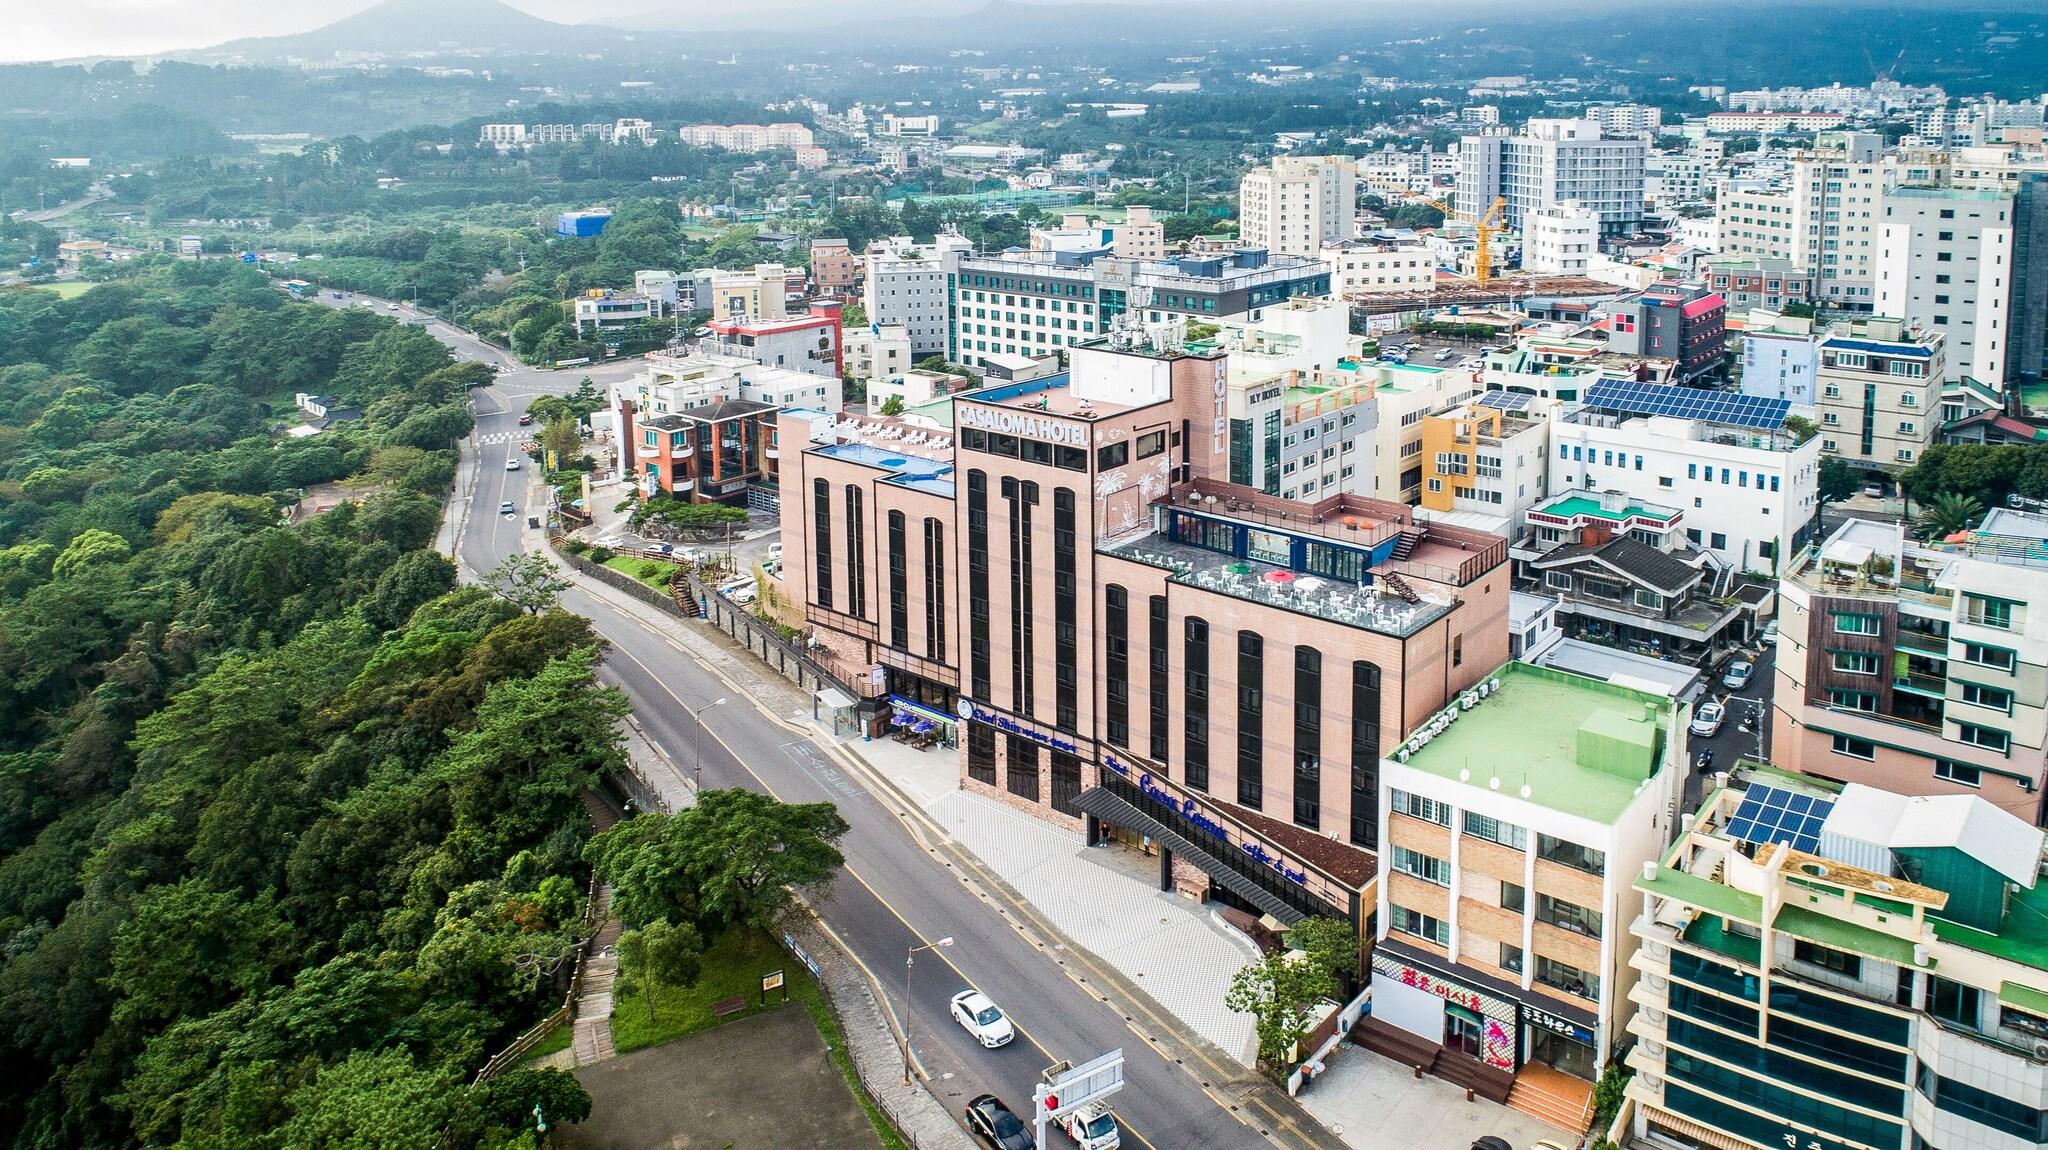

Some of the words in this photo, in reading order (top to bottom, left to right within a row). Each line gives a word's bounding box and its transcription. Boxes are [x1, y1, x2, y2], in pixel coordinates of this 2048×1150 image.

[1214, 360, 1225, 454] HOTEL
[1262, 388, 1281, 401] HOTEL
[959, 406, 1038, 436] CASALOMA
[1039, 420, 1088, 446] HOTEL
